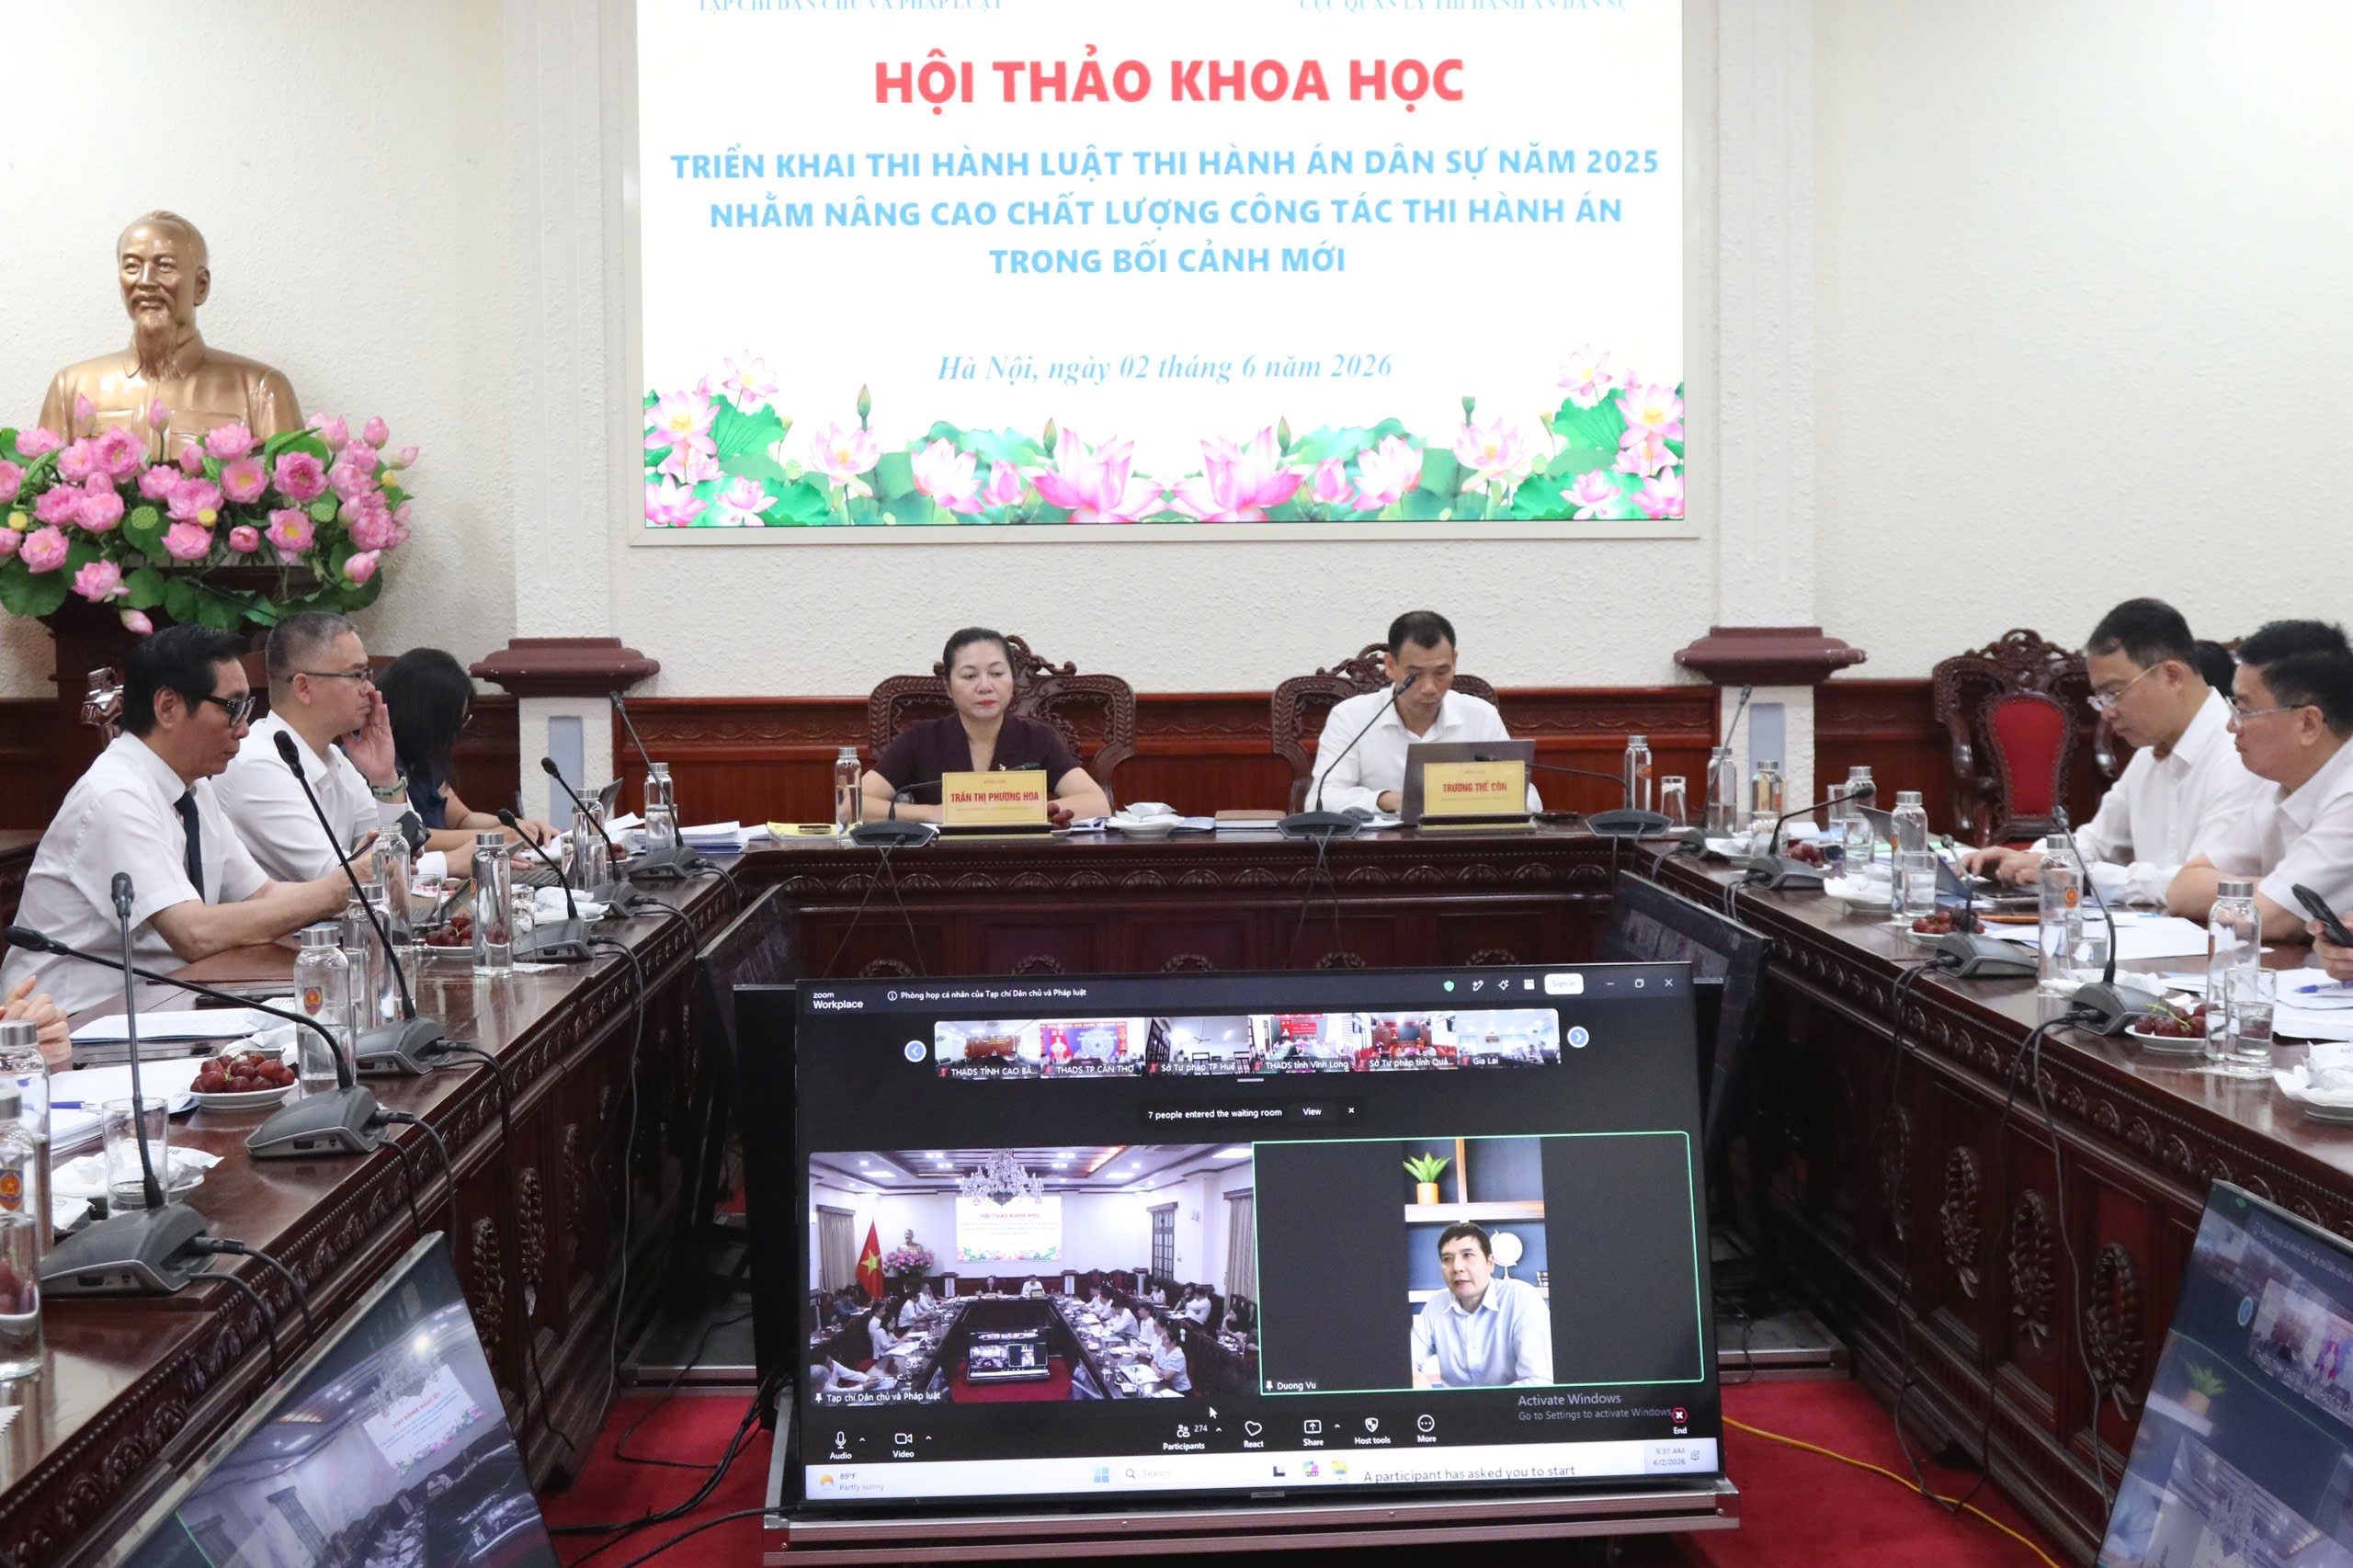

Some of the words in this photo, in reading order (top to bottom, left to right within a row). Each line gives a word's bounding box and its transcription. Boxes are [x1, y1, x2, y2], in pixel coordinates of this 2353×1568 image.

[875, 49, 973, 116] HỘI
[993, 44, 1152, 103] THẢO
[1171, 59, 1331, 102] KHOA
[1349, 58, 1464, 113] HỌC
[670, 142, 765, 178] TRIỂN
[777, 153, 855, 177] KHAI
[866, 153, 920, 177] THI
[932, 145, 1029, 176] HÀNH
[1040, 144, 1123, 182] LUẬT
[1132, 152, 1188, 176] THI
[1199, 144, 1295, 175] HÀNH
[1306, 143, 1354, 175] ÁN
[1365, 142, 1435, 175] DÂN
[1446, 147, 1489, 180] SỰ
[1499, 142, 1575, 174] NĂM
[1586, 150, 1658, 173] 2025
[710, 191, 813, 228] NHẰM
[825, 195, 920, 226] NÂNG
[931, 202, 997, 226] CAO
[1007, 191, 1095, 225] CHẤT
[1106, 197, 1220, 231] LƯỢNG
[1230, 192, 1321, 224] CÔNG
[1331, 192, 1392, 223] TÁC
[1403, 199, 1457, 223] THI
[1469, 192, 1564, 222] HÀNH
[1575, 191, 1621, 222] ÁN
[989, 249, 1102, 274] TRONG
[1113, 239, 1167, 273] BỐI
[1177, 238, 1269, 273] CẢNH
[1281, 240, 1345, 272] MỚI
[938, 356, 976, 381] Hà
[985, 355, 1039, 386] Nội,
[1048, 355, 1111, 386] ngày
[1120, 354, 1151, 380] 02
[1158, 353, 1233, 384] tháng
[1242, 354, 1256, 378] 6
[1264, 355, 1322, 378] năm
[1330, 353, 1392, 378] 2026
[974, 792, 986, 804] THỊ
[1023, 791, 1040, 801] HOA
[900, 991, 925, 1001] Phòng
[926, 991, 940, 1000] họp
[941, 990, 950, 998] cá
[951, 990, 970, 999] nhân
[985, 990, 999, 999] Tạp
[1000, 989, 1012, 997] chí
[1013, 989, 1028, 997] Dân
[1029, 988, 1042, 997] chủ
[1053, 988, 1072, 998] Pháp
[1073, 988, 1087, 997] luật
[813, 1000, 864, 1011] Workplace
[1329, 1061, 1349, 1070] Long
[1472, 1057, 1485, 1065] Gia
[1487, 1056, 1499, 1064] Lai
[951, 1068, 978, 1076] THADS
[1002, 1067, 1019, 1075] CAO
[1057, 1065, 1084, 1074] THADS
[1085, 1065, 1095, 1074] TP
[1117, 1063, 1135, 1073] THƠ
[1174, 1063, 1185, 1072] Tư
[1209, 1062, 1218, 1071] TP
[1155, 1111, 1183, 1120] people
[1185, 1110, 1215, 1119] entered
[1216, 1109, 1229, 1118] the
[1231, 1108, 1259, 1119] waiting
[1302, 1108, 1322, 1116] View
[1277, 1381, 1303, 1392] Duong
[1304, 1381, 1316, 1390] Vu
[826, 1393, 842, 1403] Tạp
[844, 1392, 857, 1402] chí
[904, 1392, 925, 1403] Pháp
[1518, 1394, 1565, 1406] Activate
[1567, 1392, 1621, 1405] Windows
[1518, 1412, 1532, 1421] Go
[1533, 1412, 1543, 1420] to
[1545, 1410, 1581, 1422] Settings
[1583, 1410, 1593, 1419] to
[1595, 1409, 1630, 1418] activate
[1631, 1407, 1672, 1417] Windows
[1194, 1425, 1209, 1433] 274
[1673, 1426, 1688, 1435] End
[1302, 1437, 1324, 1447] Share
[1354, 1437, 1372, 1445] Host
[1372, 1436, 1392, 1444] tools
[1417, 1434, 1437, 1443] More
[1163, 1442, 1206, 1451] Participants
[1244, 1440, 1265, 1449] React
[829, 1451, 853, 1460] Audio
[892, 1449, 915, 1459] Video
[1363, 1471, 1372, 1482] A
[1375, 1470, 1441, 1483] participant
[1445, 1469, 1465, 1480] has
[1468, 1467, 1503, 1479] asked
[1506, 1469, 1529, 1480] you
[1531, 1468, 1545, 1477] to
[1548, 1465, 1576, 1476] start
[839, 1483, 860, 1493] Partly
